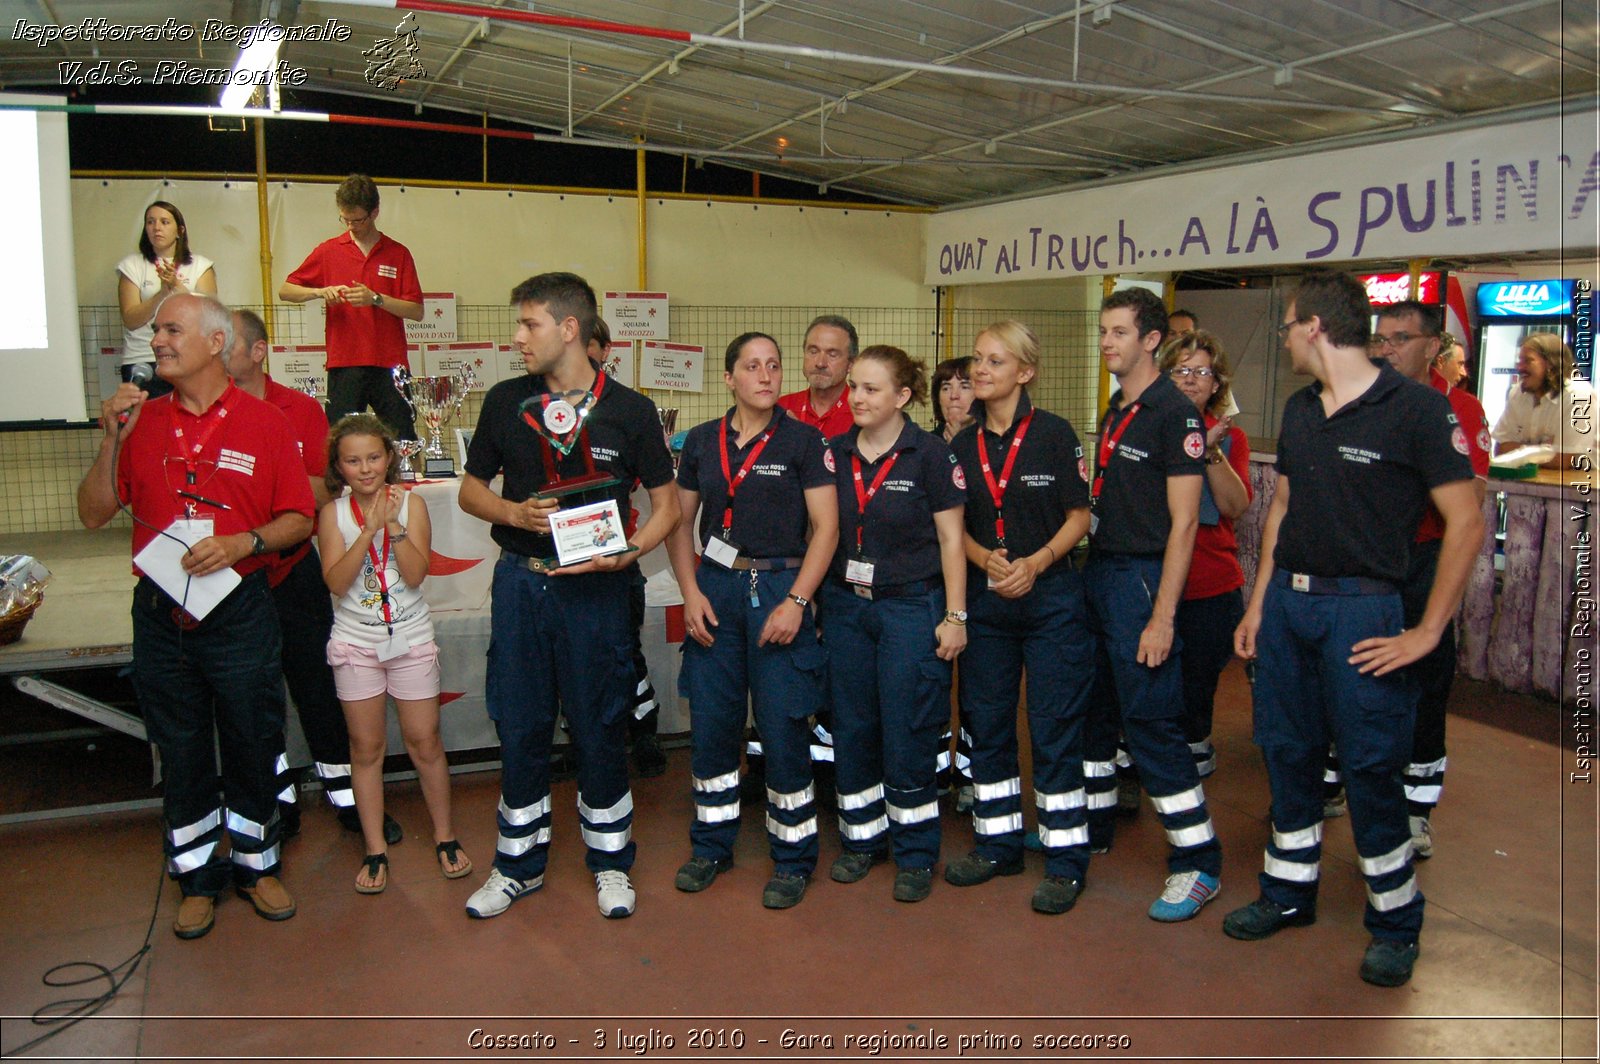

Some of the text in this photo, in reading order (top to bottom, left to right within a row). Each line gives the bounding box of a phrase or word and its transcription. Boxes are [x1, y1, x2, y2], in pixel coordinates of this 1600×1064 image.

[940, 237, 988, 275] QUAT
[995, 239, 1020, 274] AL
[1179, 217, 1210, 255] A
[1495, 283, 1549, 301] LILIA
[660, 371, 685, 379] SQUADRA
[655, 379, 690, 388] MONCALVO
[1338, 446, 1381, 460] CROCE ROSSA
[1343, 454, 1371, 464] ITALIANA
